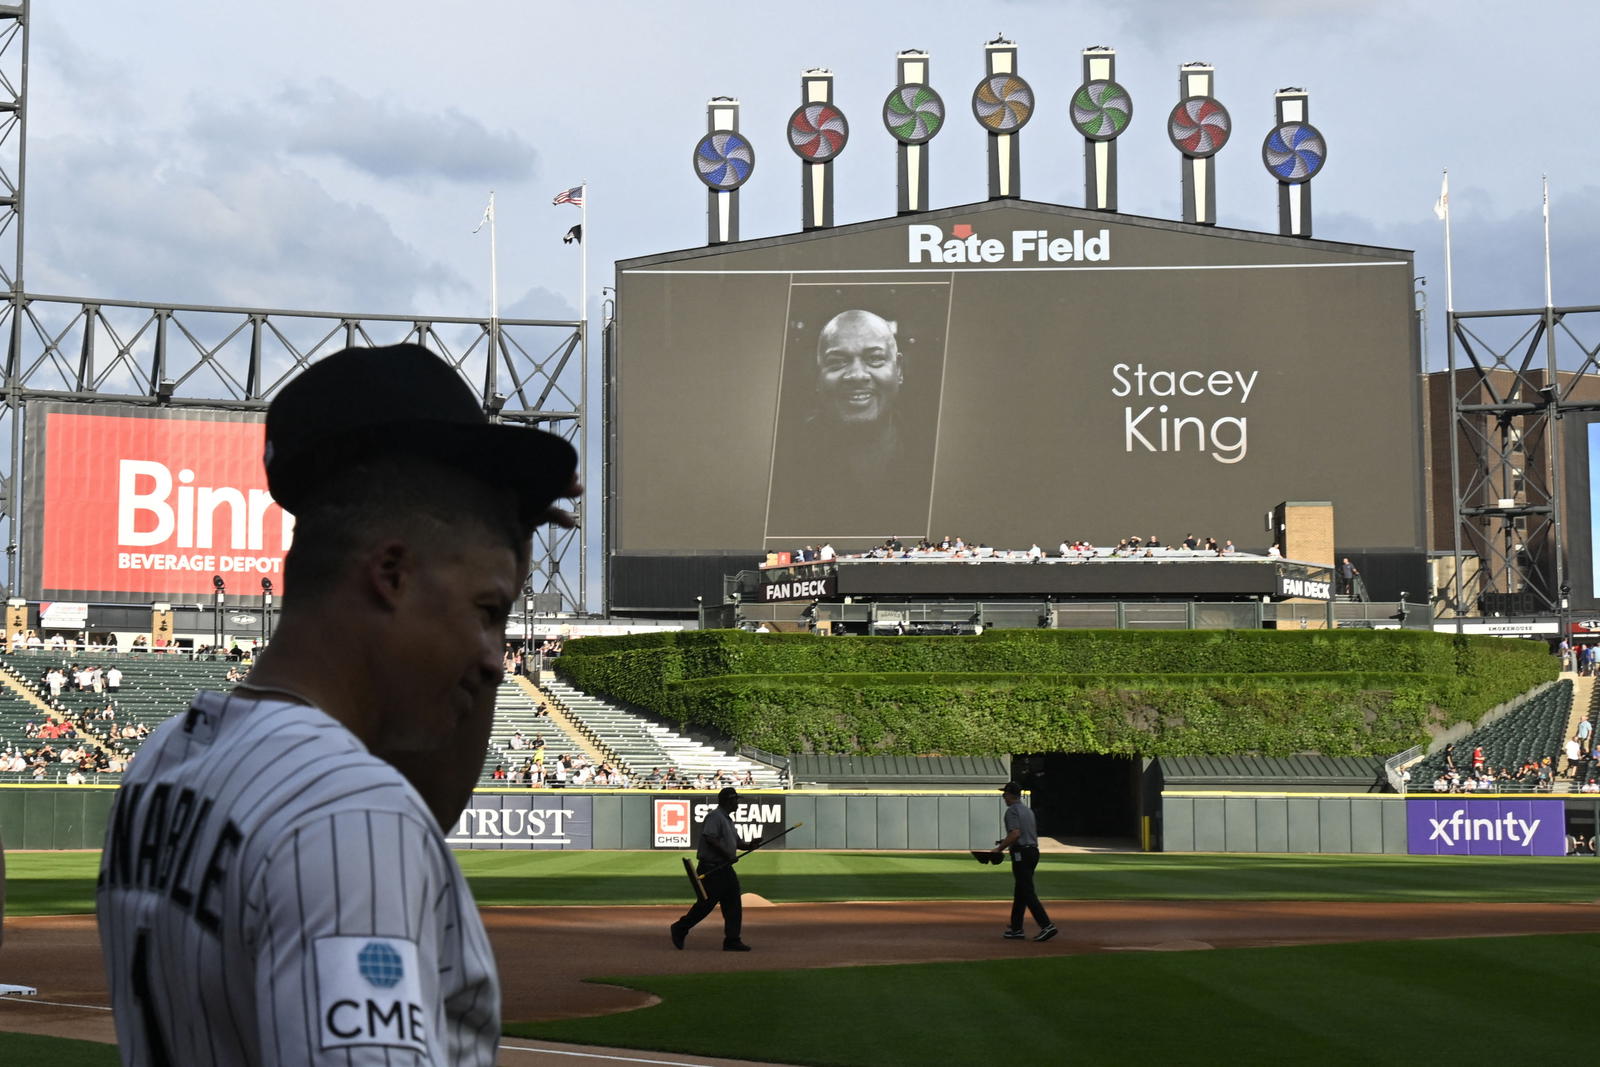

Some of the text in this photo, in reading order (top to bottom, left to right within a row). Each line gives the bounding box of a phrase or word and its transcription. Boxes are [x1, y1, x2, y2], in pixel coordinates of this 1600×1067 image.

[908, 224, 1110, 263] Rate Field
[1111, 363, 1259, 404] Stacey
[1125, 404, 1248, 464] King
[118, 459, 296, 551] Binn
[118, 552, 283, 573] BEVERAGE DEPOT
[766, 580, 826, 599] FAN DECK
[1283, 578, 1330, 599] FAN DECK
[455, 808, 575, 837] TRUST
[657, 836, 688, 844] CHSN
[1429, 809, 1541, 847] xfinity
[326, 998, 426, 1044] CME
